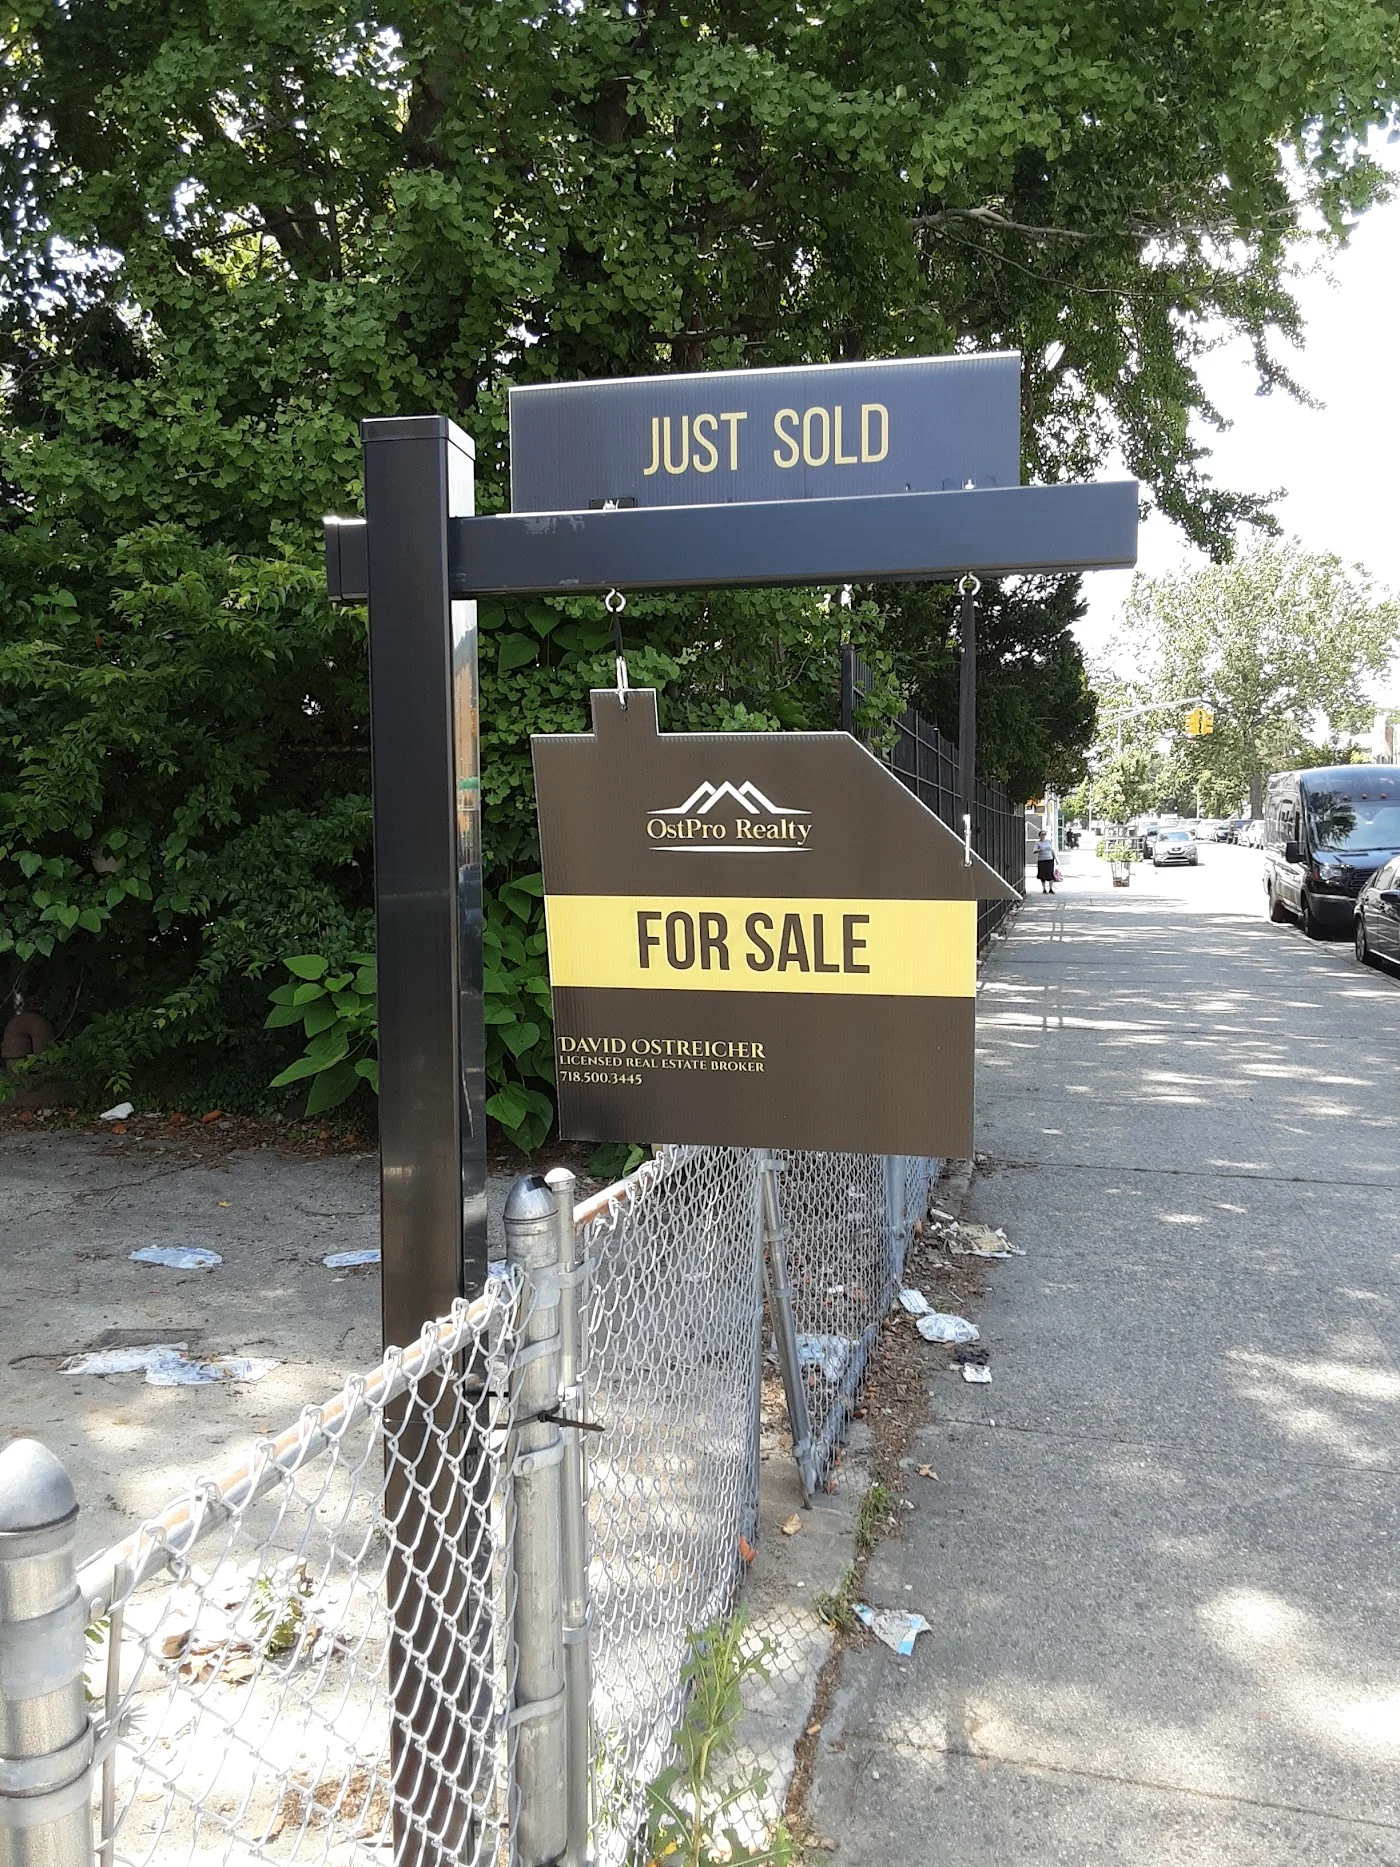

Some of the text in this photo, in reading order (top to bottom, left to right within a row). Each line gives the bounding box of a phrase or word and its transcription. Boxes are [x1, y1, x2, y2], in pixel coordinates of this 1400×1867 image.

[643, 403, 889, 476] JUST SOLD
[646, 818, 813, 845] OstPro Realty
[636, 910, 871, 974] FOR SALE
[557, 1036, 766, 1059] DAVID OSTREICHER
[559, 1055, 765, 1072] LICENSED REAL ESTATE BROKER
[559, 1070, 643, 1085] 718.500.3445
